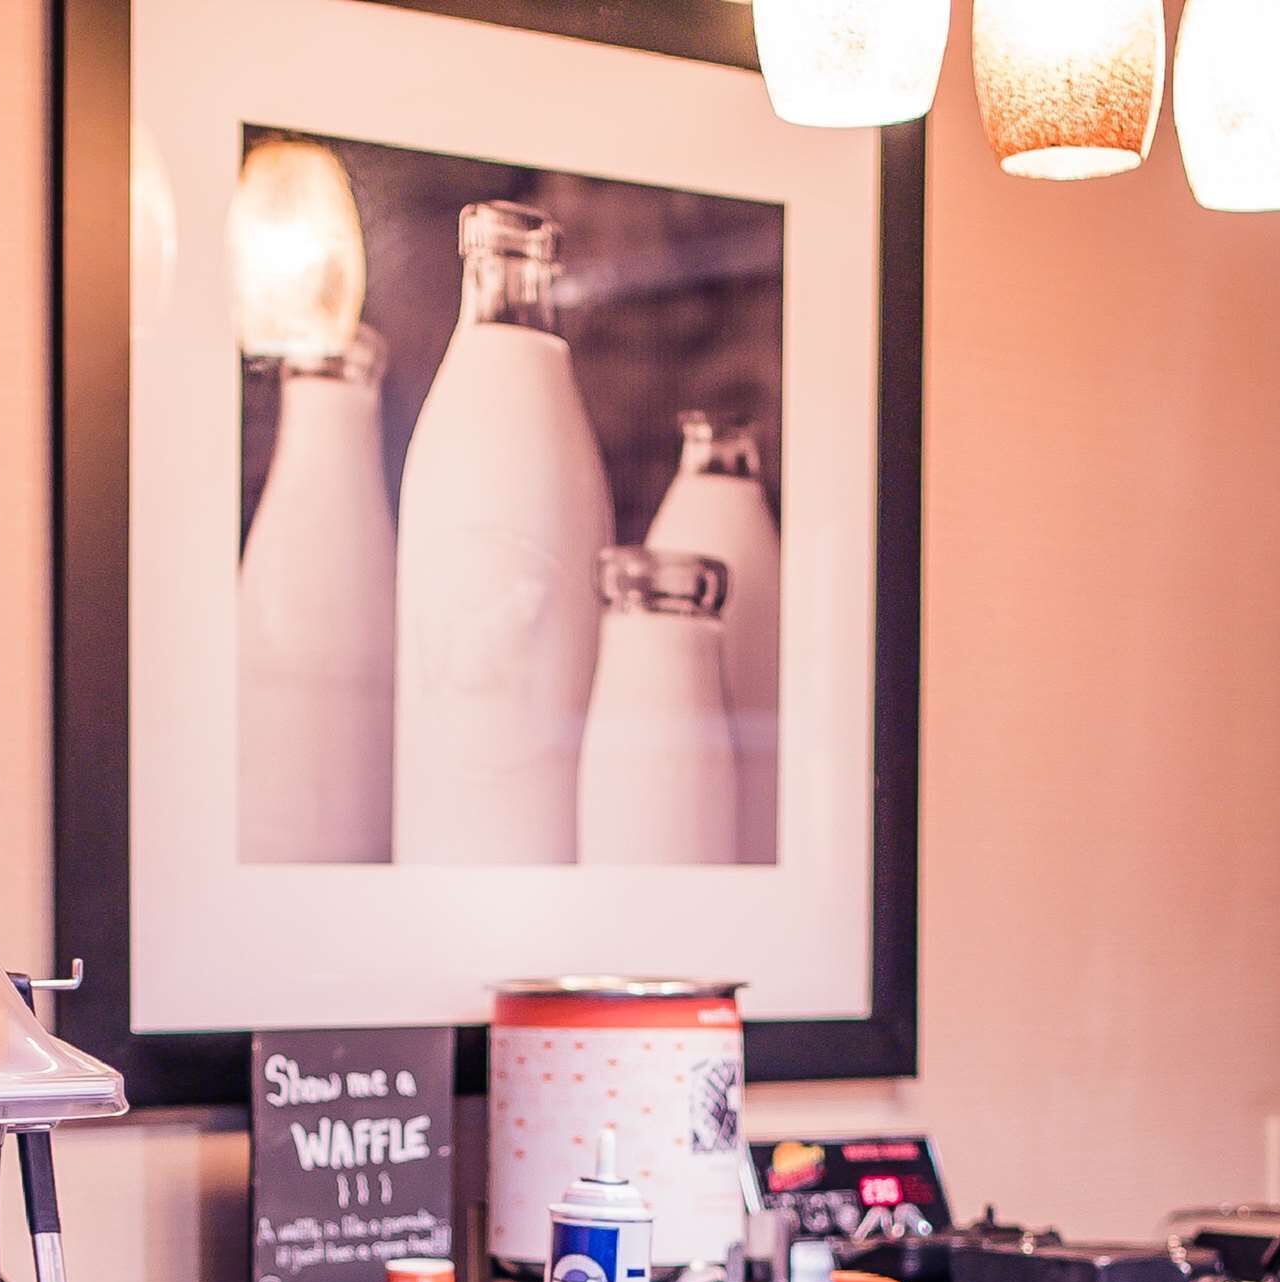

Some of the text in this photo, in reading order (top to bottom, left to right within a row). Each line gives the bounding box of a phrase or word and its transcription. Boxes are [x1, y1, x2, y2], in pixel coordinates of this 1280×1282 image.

[264, 1054, 417, 1106] Show me a
[290, 1115, 431, 1171] WAFFLE
